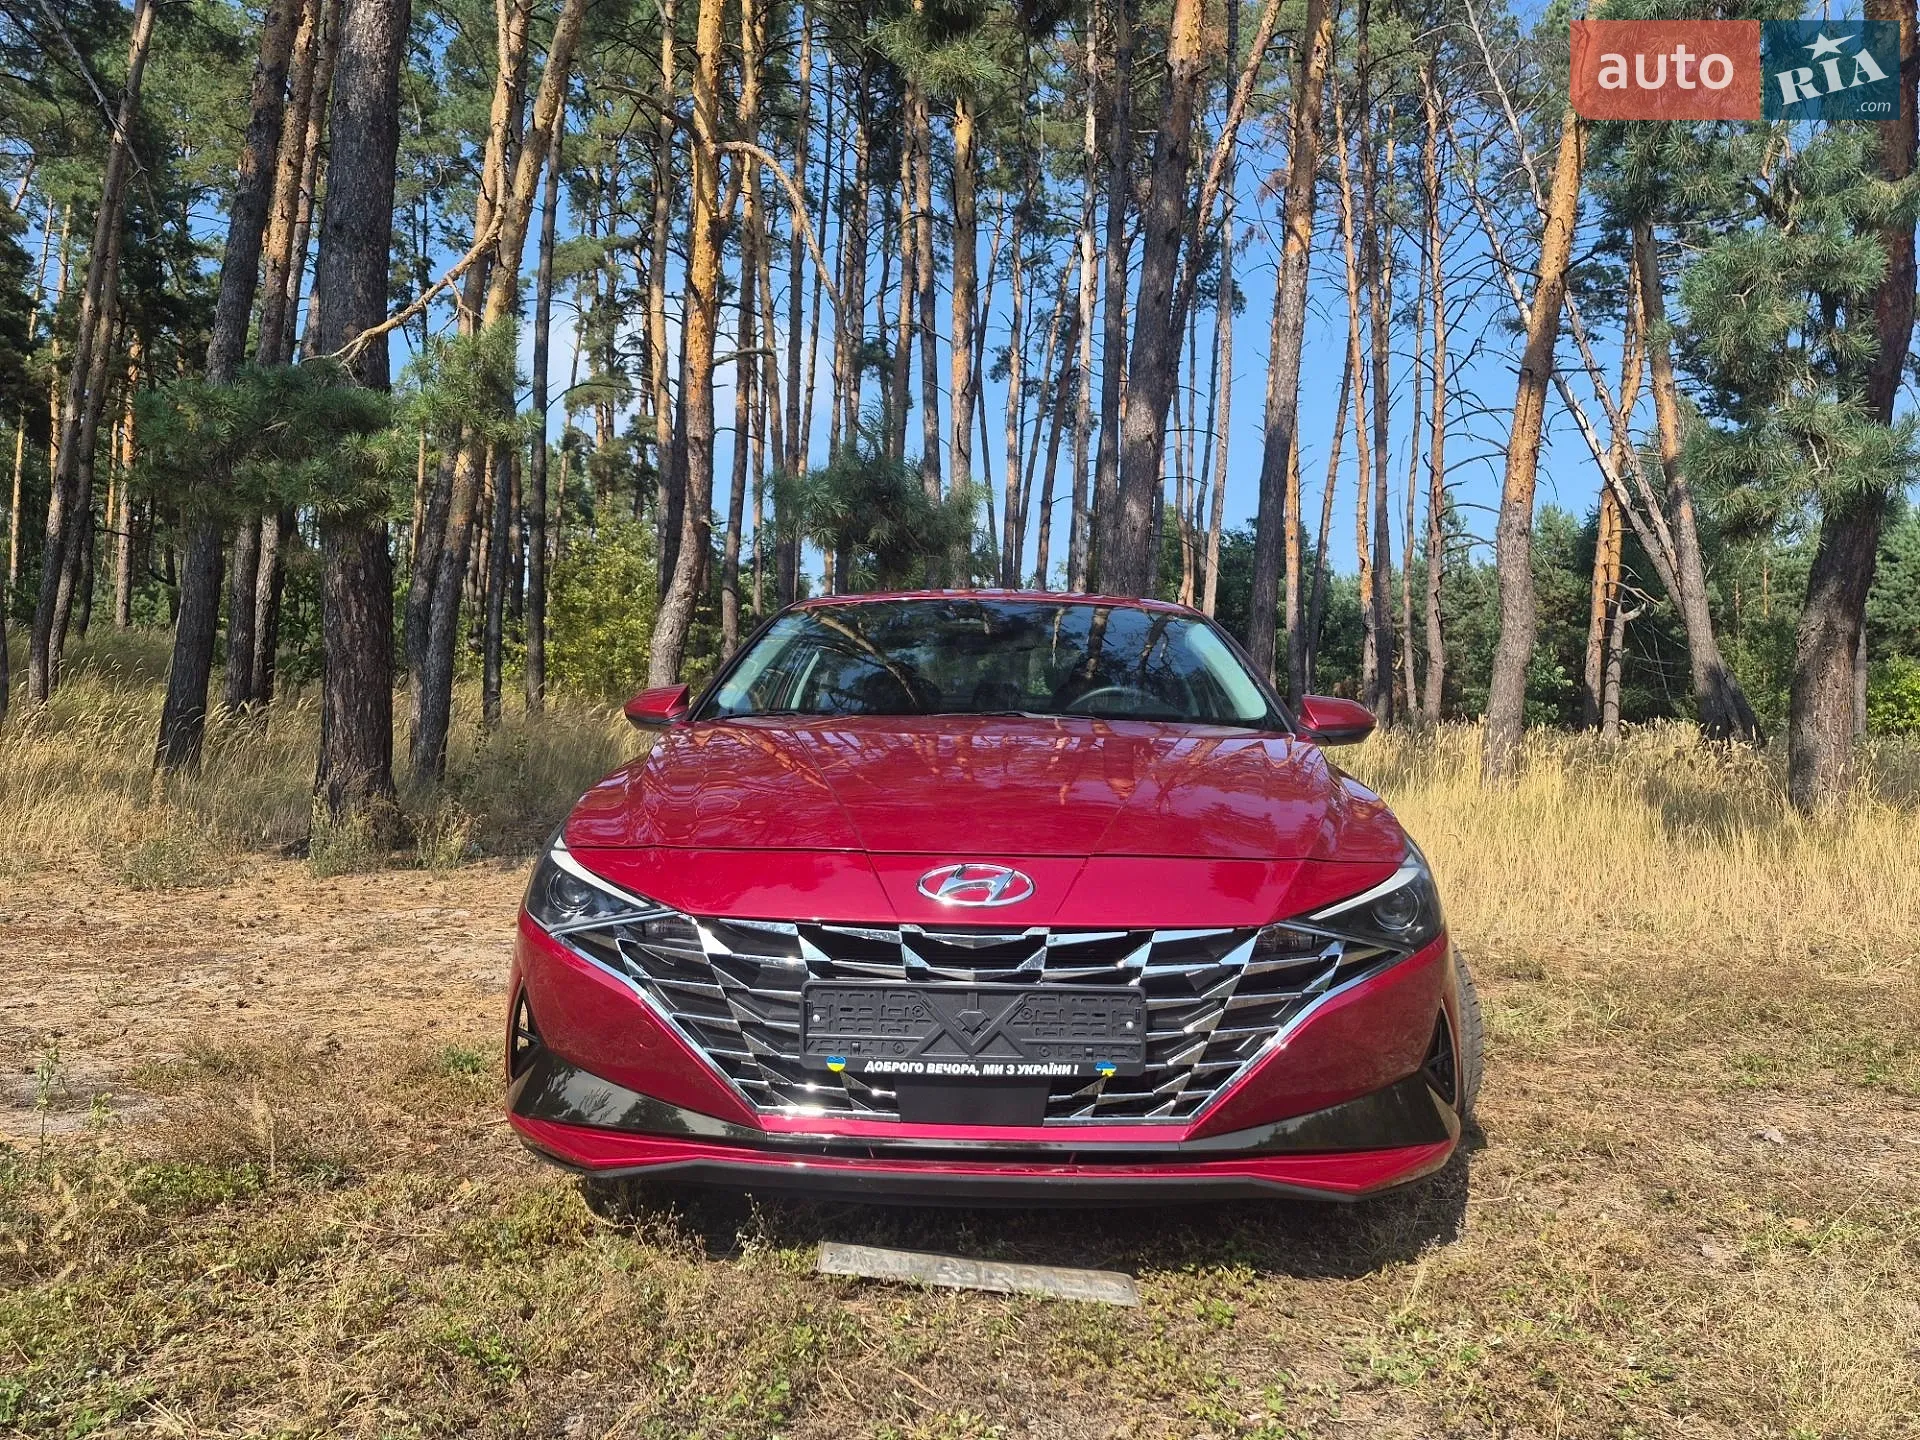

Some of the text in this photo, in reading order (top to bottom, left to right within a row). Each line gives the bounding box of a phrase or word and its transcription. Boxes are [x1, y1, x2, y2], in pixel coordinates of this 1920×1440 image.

[864, 1060, 924, 1073] ДОБРОГО
[926, 1063, 979, 1076] ВЕЧОРА,
[983, 1064, 1004, 1075] МИ
[1016, 1062, 1071, 1075] УКРАЇНИ
